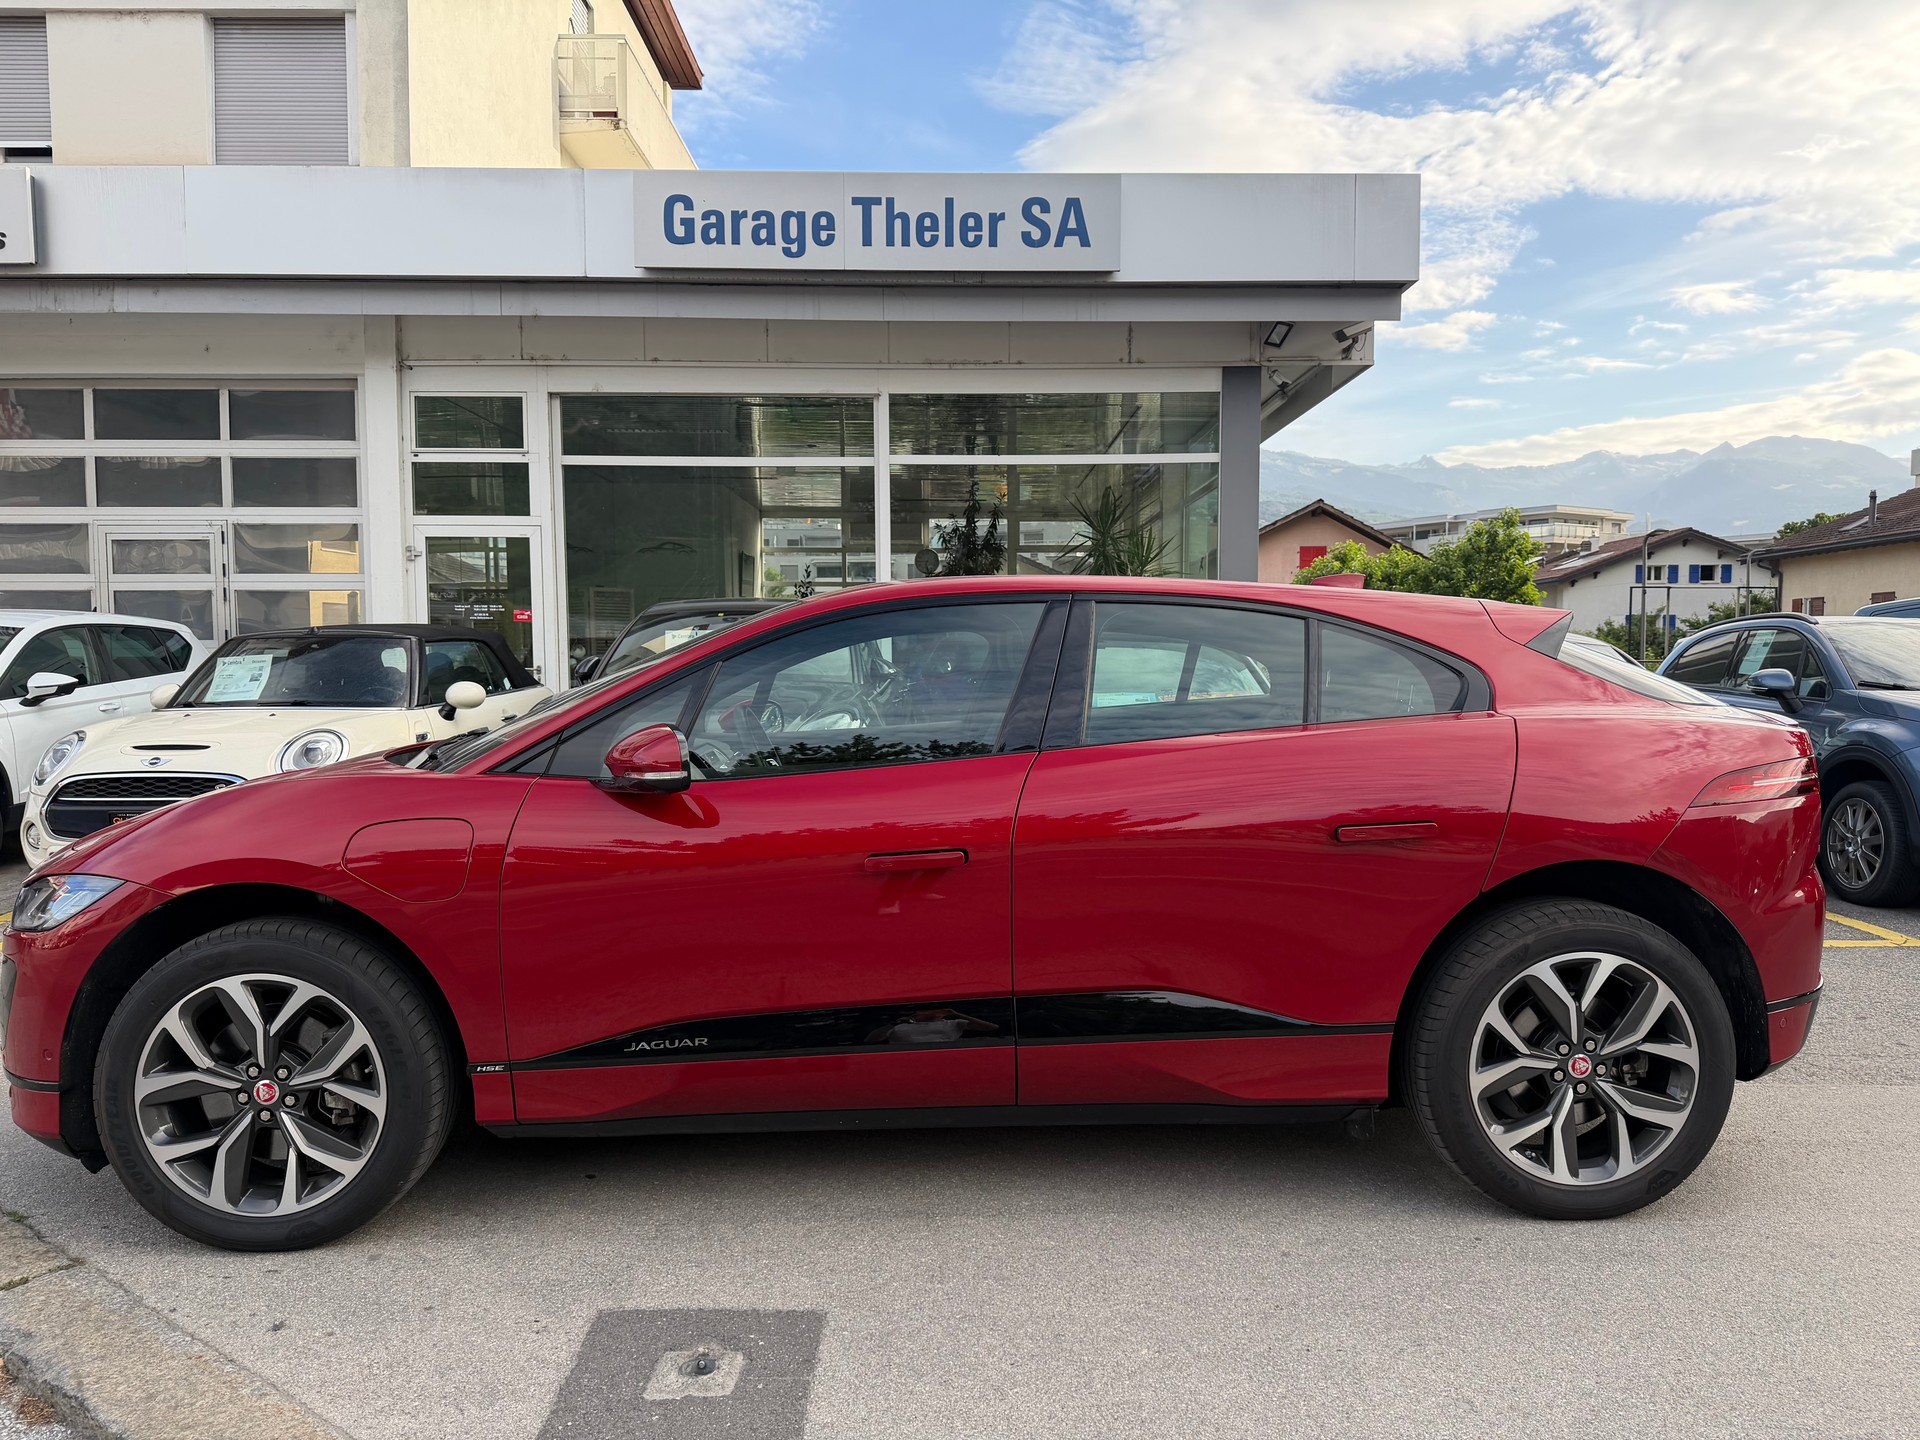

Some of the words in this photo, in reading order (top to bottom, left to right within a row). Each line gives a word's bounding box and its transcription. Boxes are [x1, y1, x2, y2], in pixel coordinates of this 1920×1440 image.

[663, 194, 835, 258] Garage
[851, 196, 1005, 247] Theler
[1020, 197, 1091, 248] SA
[623, 1037, 709, 1052] JAGUAR
